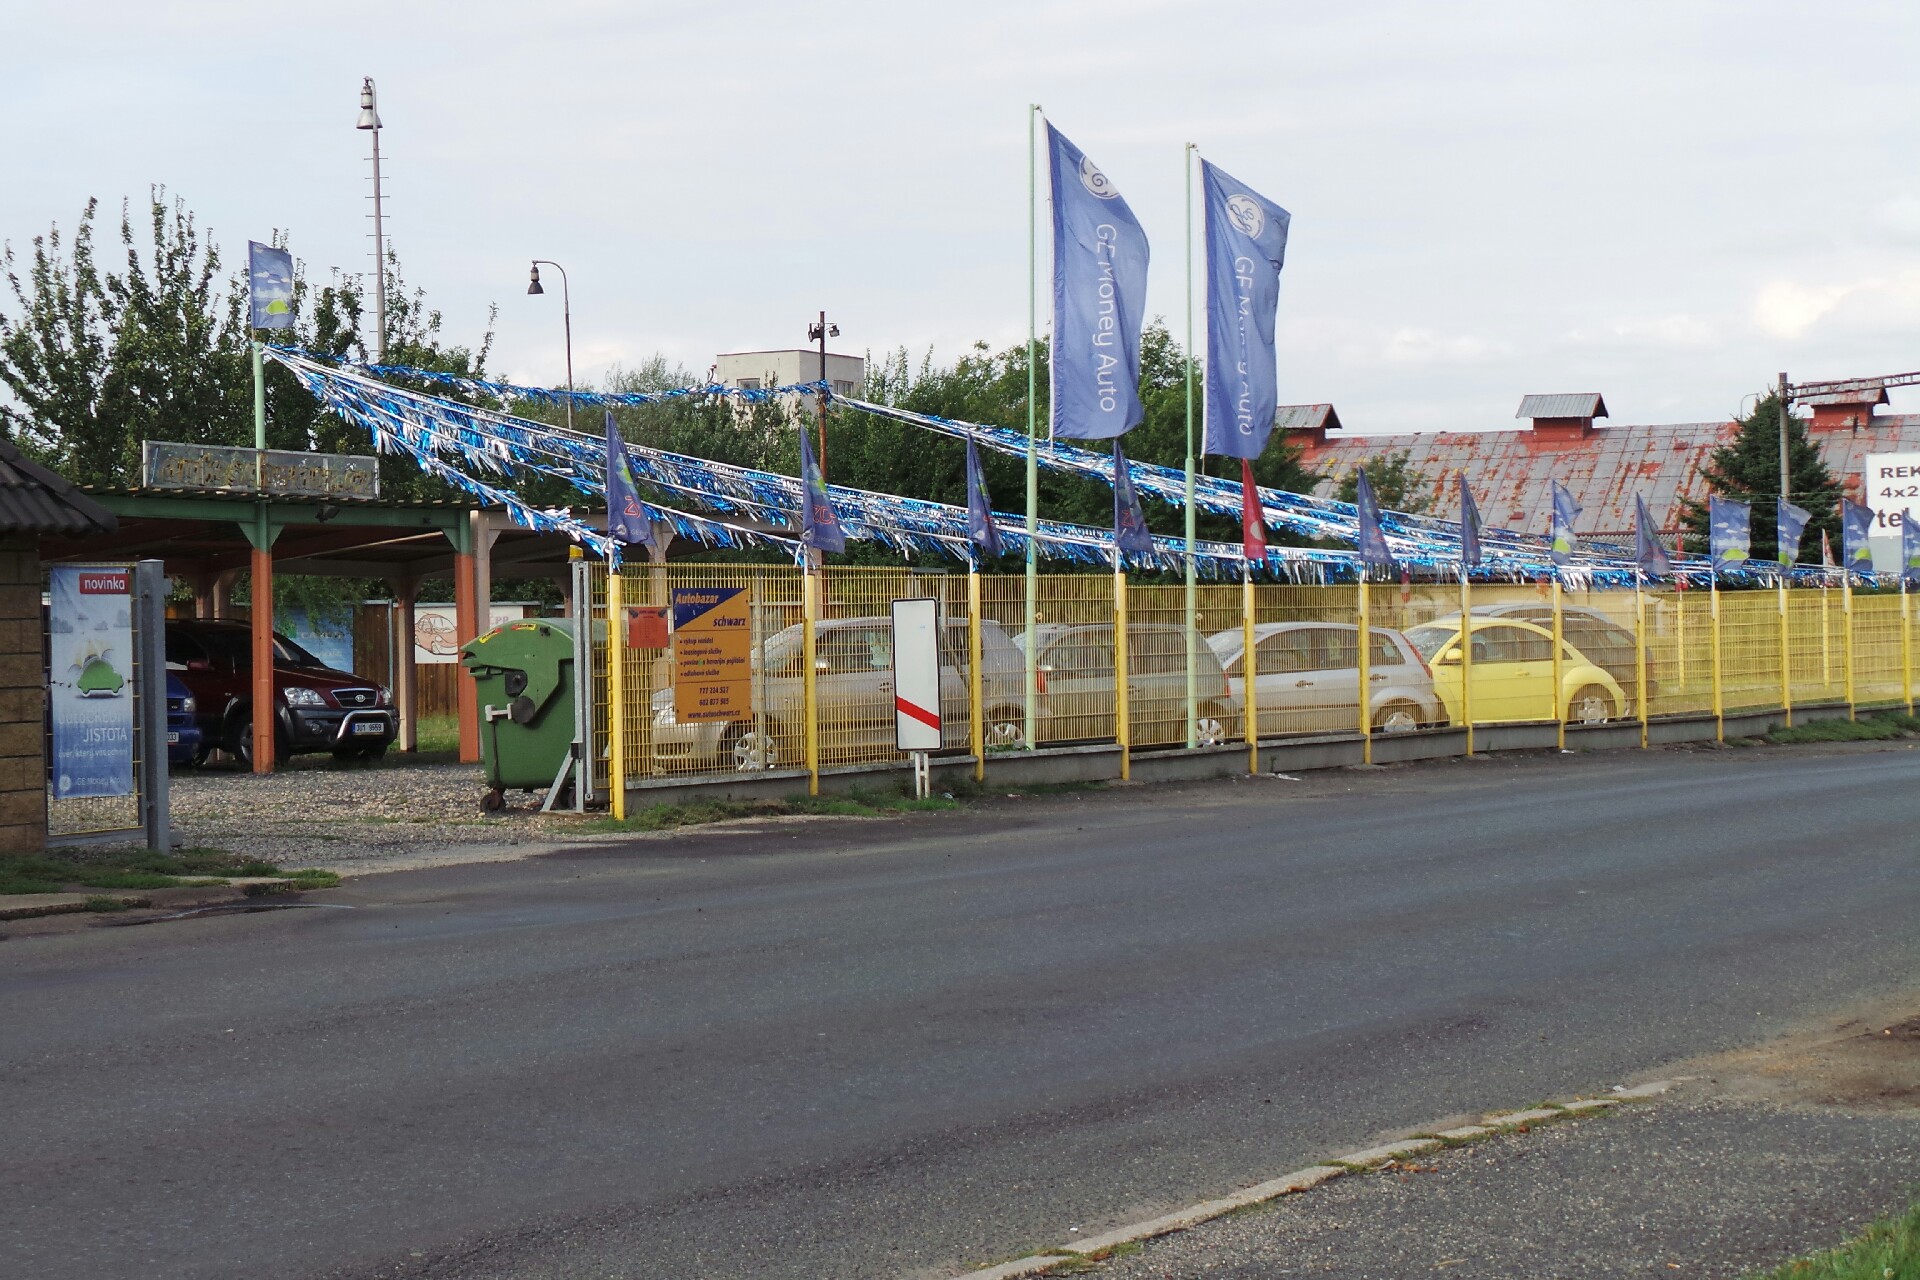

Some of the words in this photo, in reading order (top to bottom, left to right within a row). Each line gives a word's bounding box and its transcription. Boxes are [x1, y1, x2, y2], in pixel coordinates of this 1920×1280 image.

[1092, 262, 1116, 347] Money
[1096, 353, 1119, 413] Auto
[1236, 381, 1253, 436] Auto
[1880, 485, 1919, 498] 4x2
[84, 576, 126, 590] novinka
[675, 592, 719, 604] Autobazar
[713, 615, 746, 627] schwarz
[83, 727, 128, 742] JISTOTA
